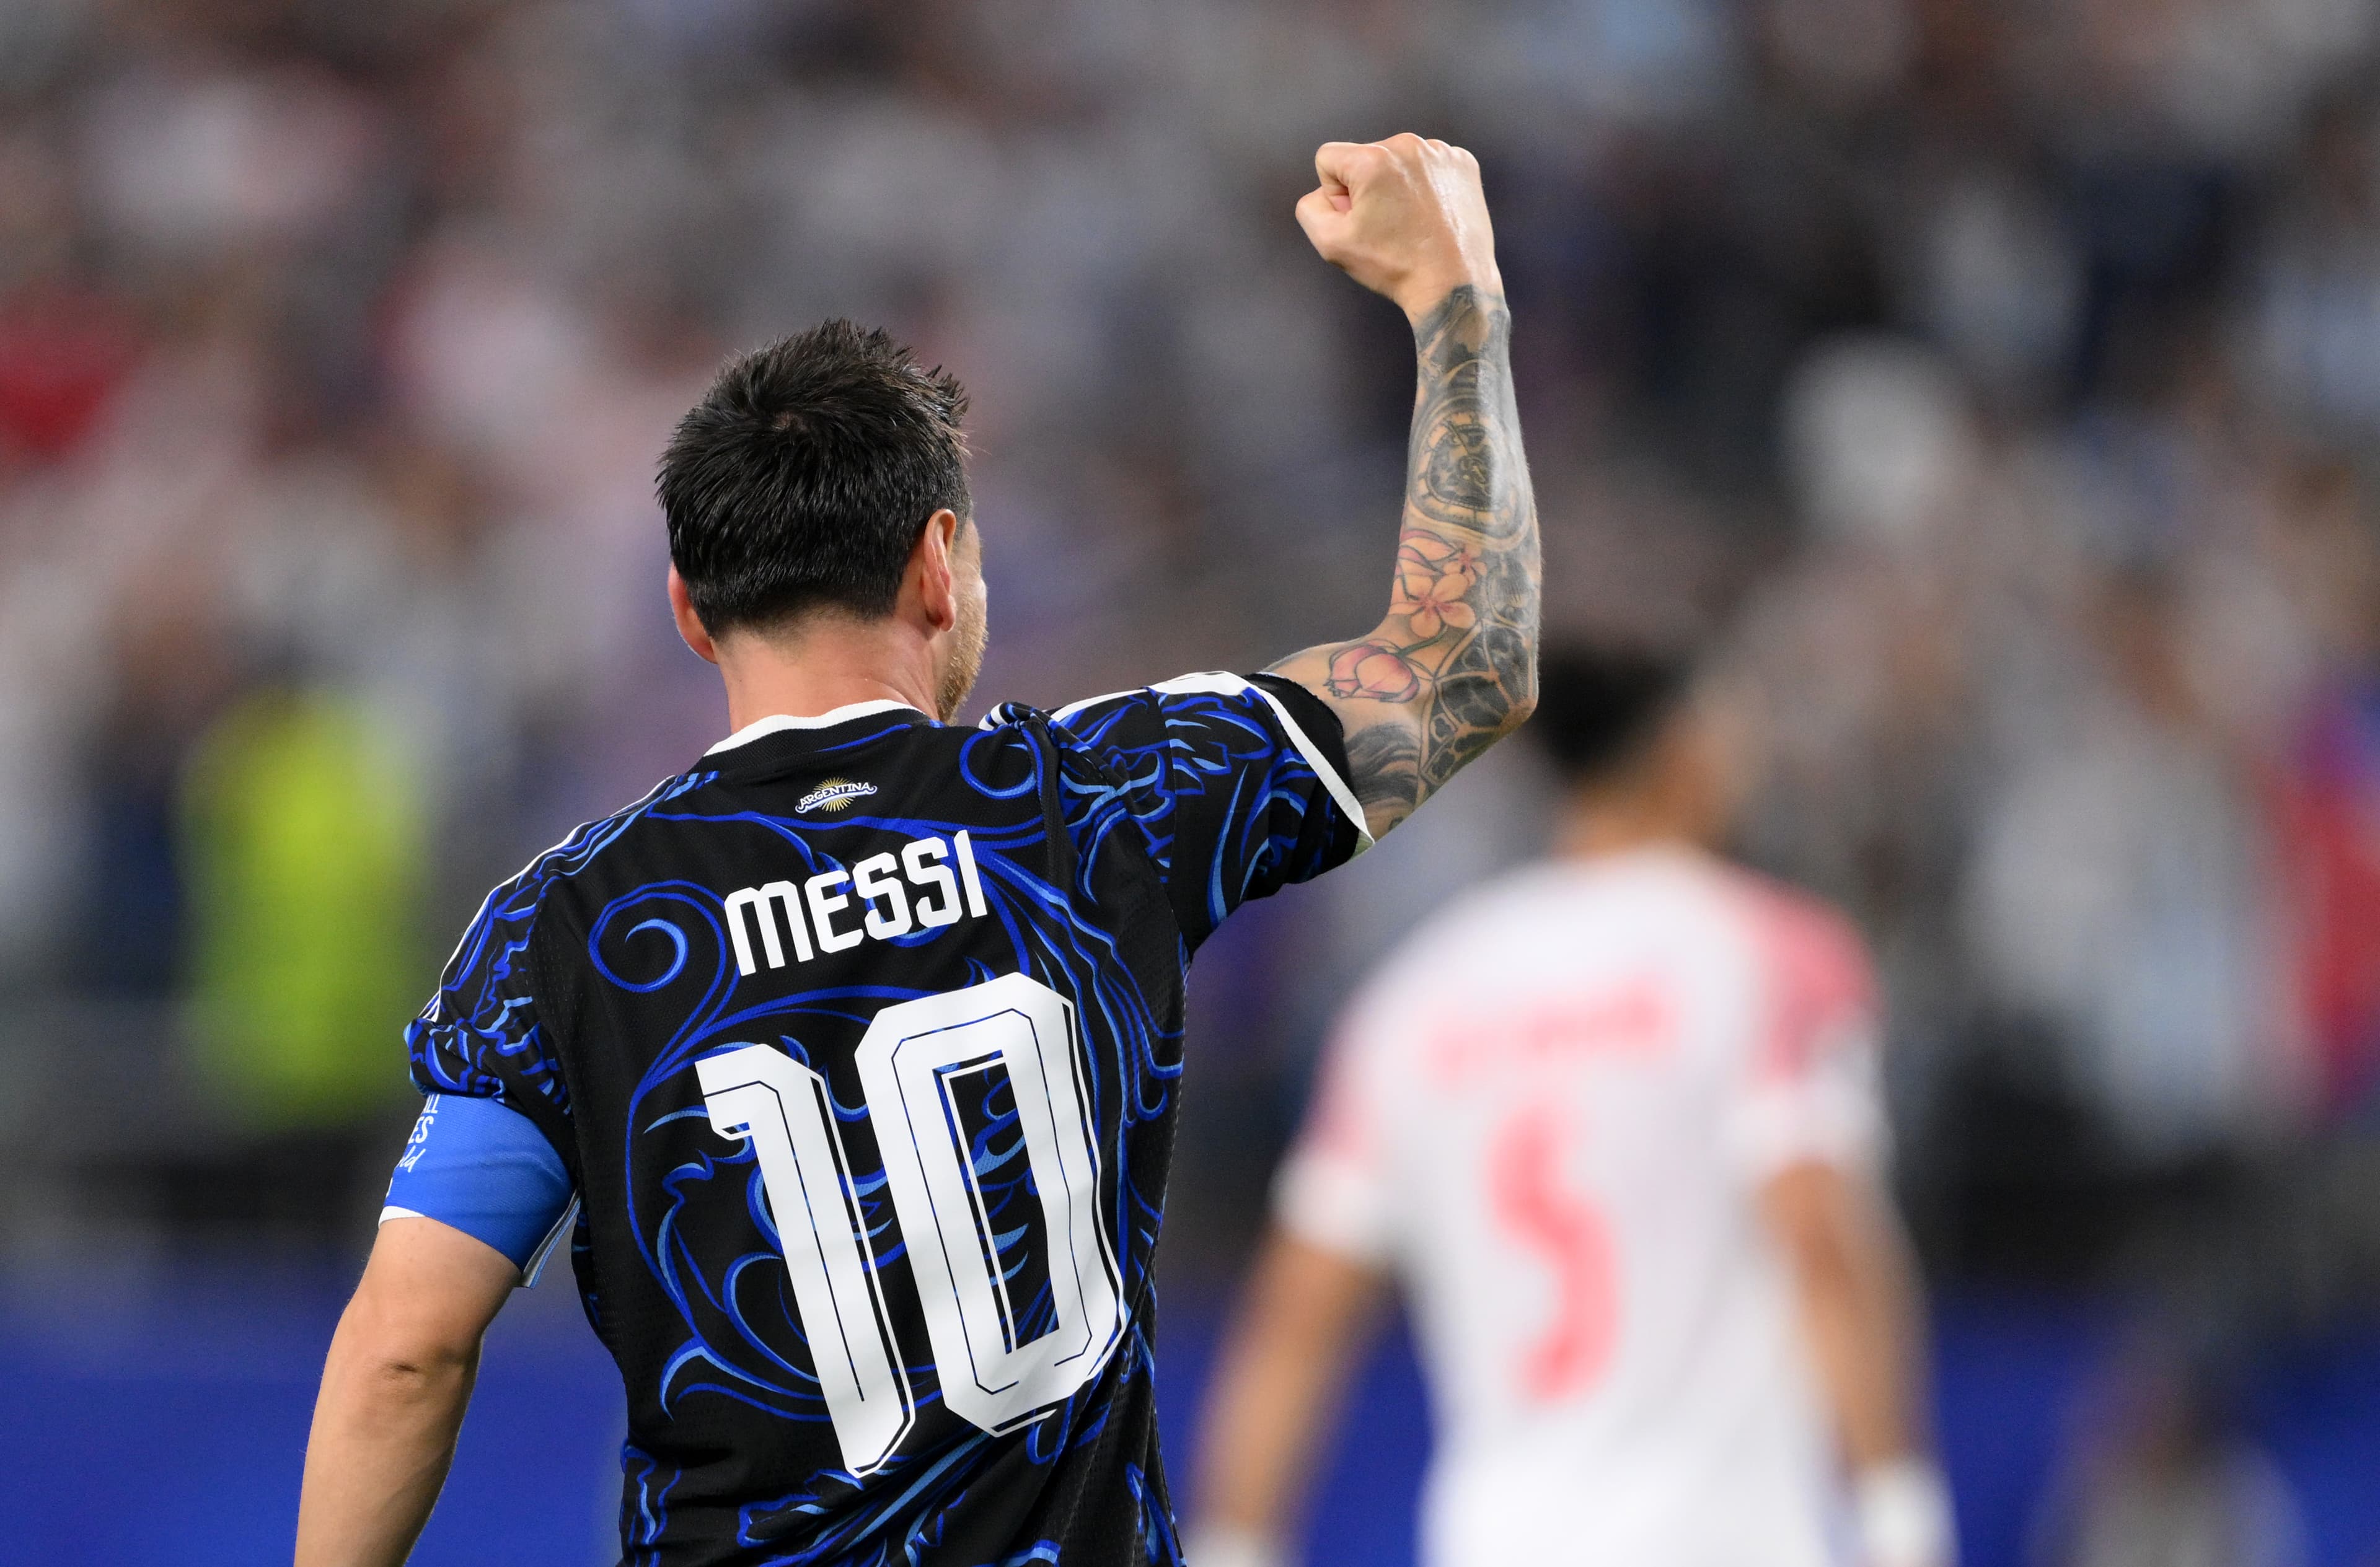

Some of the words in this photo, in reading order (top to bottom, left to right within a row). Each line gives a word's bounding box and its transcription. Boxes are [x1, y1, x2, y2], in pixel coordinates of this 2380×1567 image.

[798, 782, 873, 810] ARGENTINA
[725, 830, 987, 977] MESSI
[695, 972, 1127, 1479] 10
